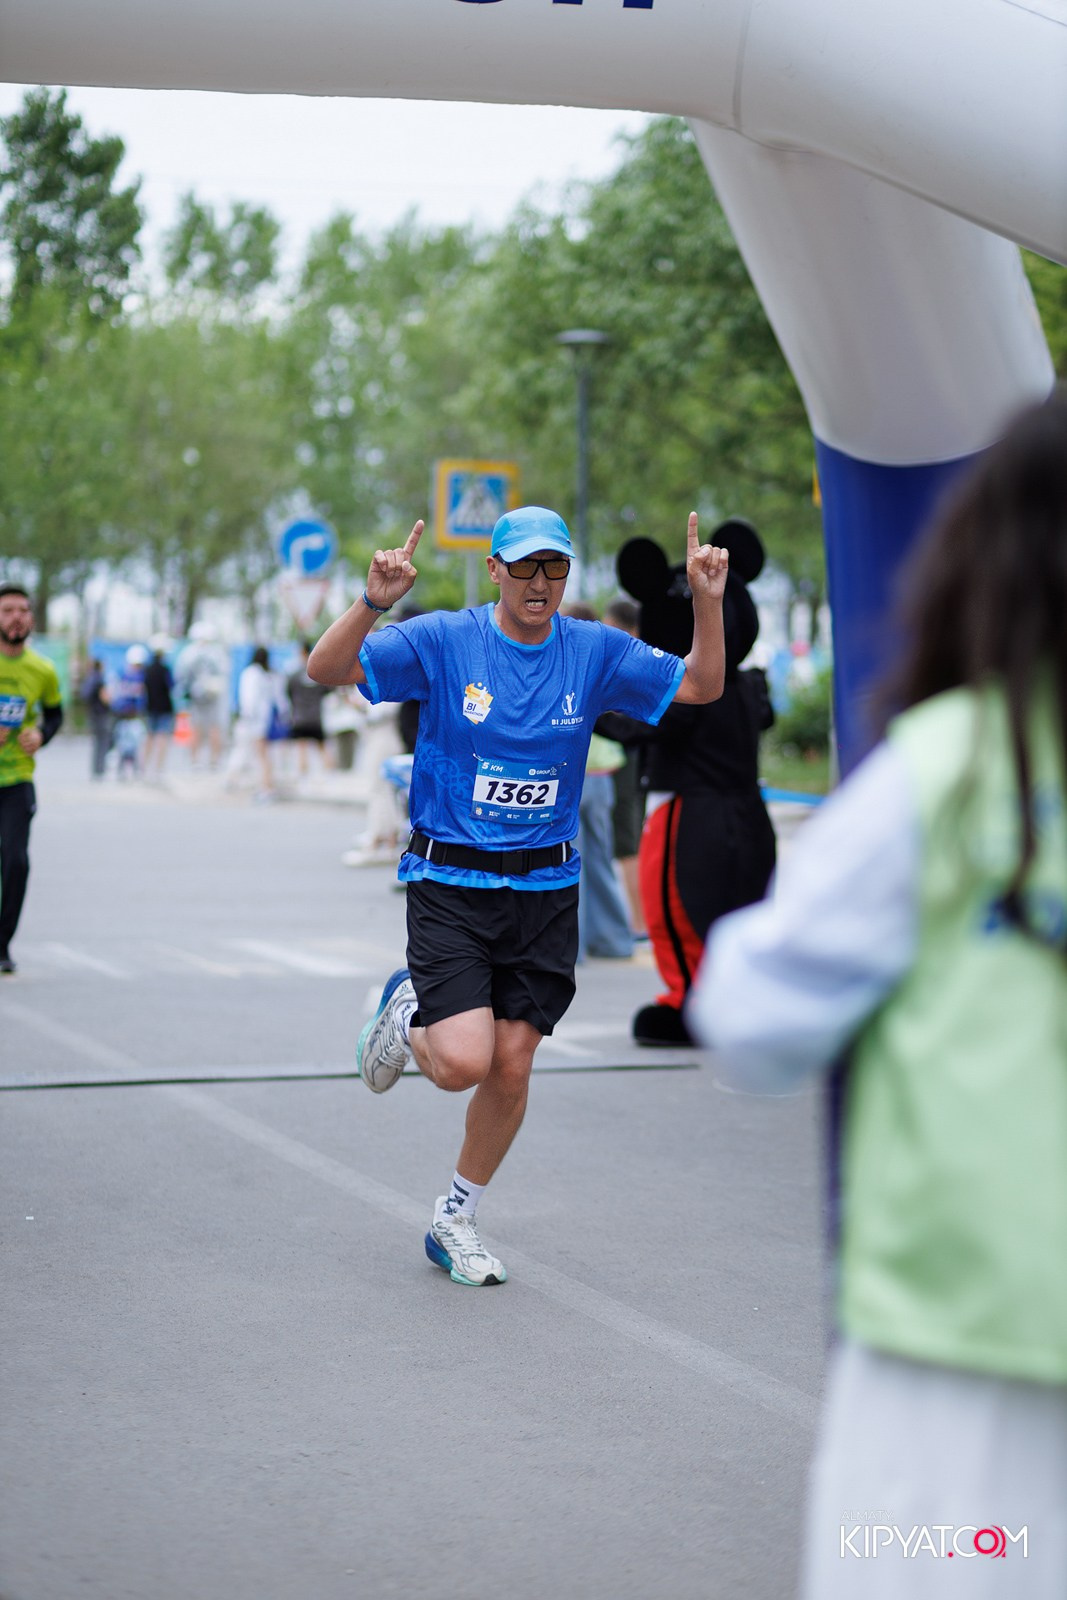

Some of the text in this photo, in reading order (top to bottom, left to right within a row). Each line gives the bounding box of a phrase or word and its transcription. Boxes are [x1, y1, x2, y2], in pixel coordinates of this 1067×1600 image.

[466, 702, 477, 711] BI
[481, 761, 504, 773] 5 KM
[485, 780, 550, 805] 1362
